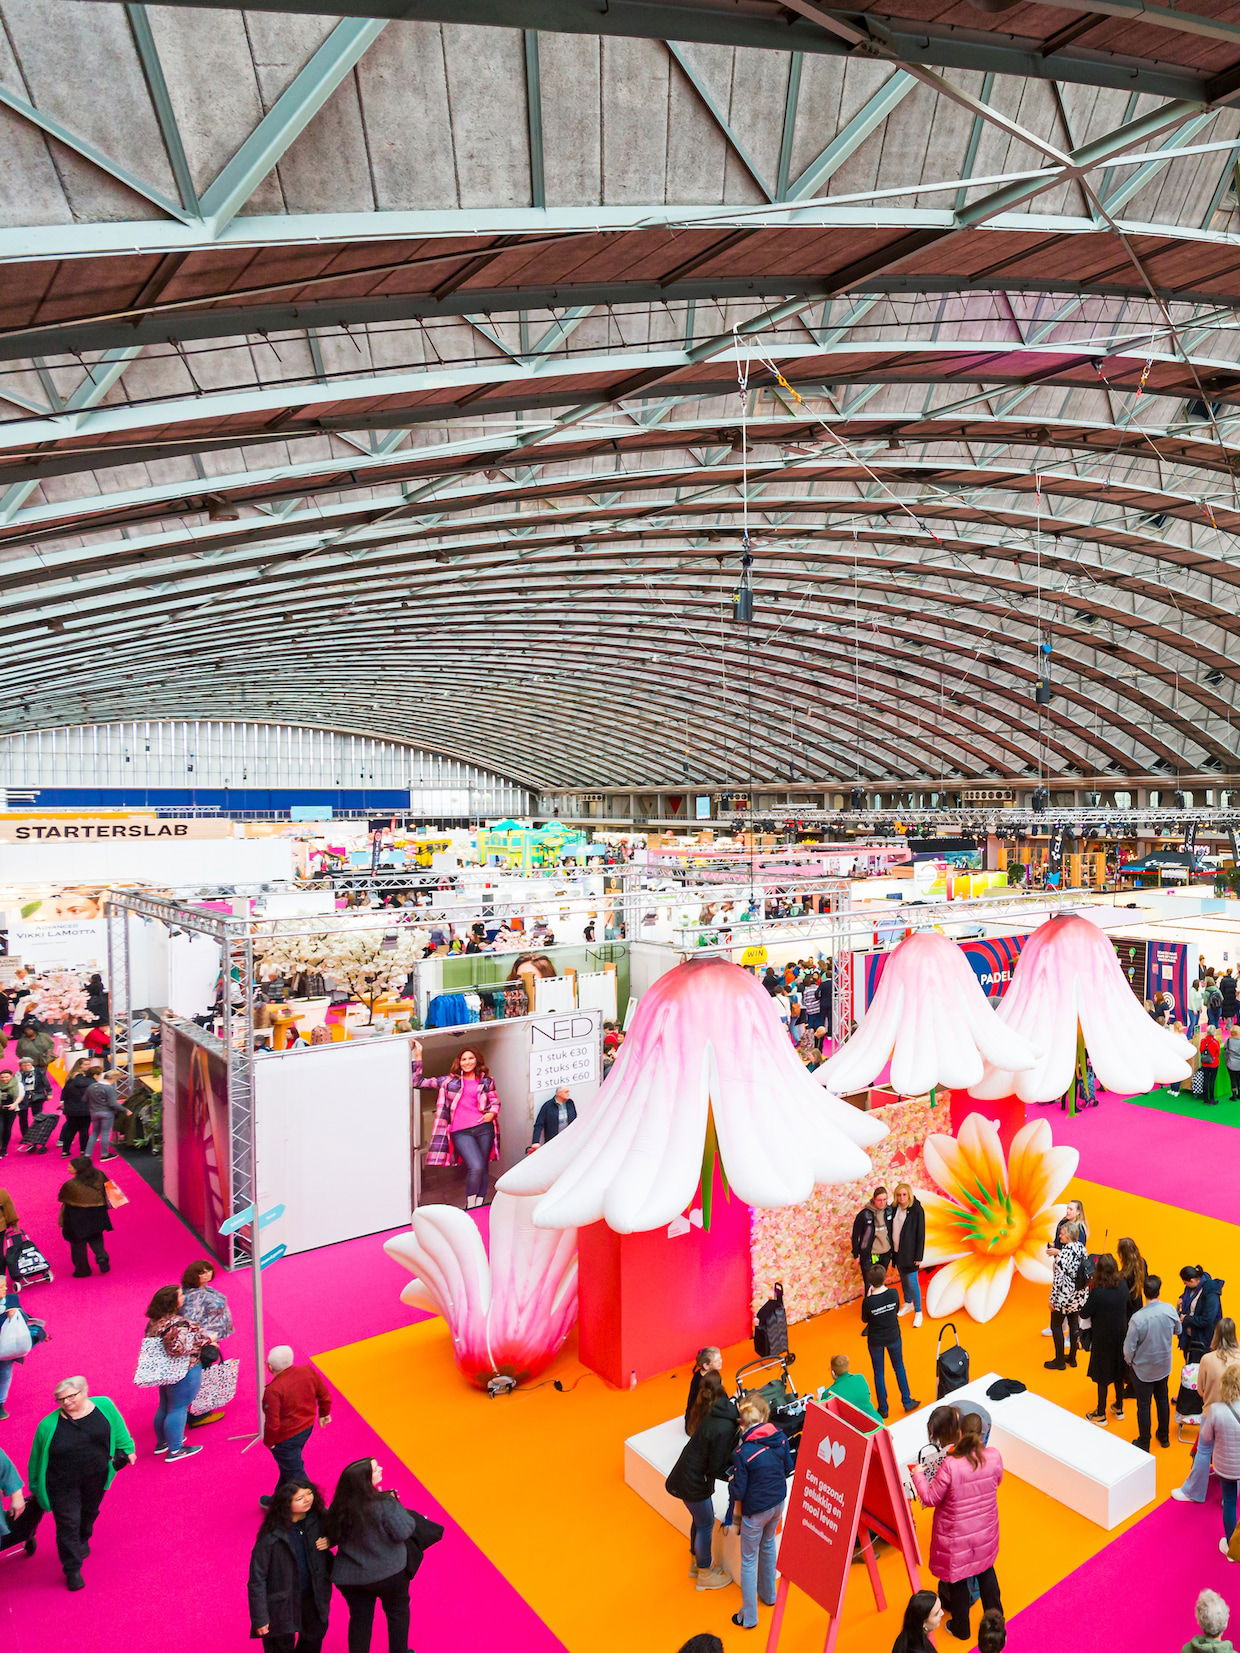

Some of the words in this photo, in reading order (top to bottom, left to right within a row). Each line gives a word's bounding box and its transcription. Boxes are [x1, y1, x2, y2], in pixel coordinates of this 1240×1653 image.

[15, 824, 188, 839] STARTERSLAB
[747, 949, 764, 958] WIN
[981, 970, 1013, 986] PADEL
[531, 1017, 593, 1045] NED
[539, 1055, 543, 1063] 1
[546, 1050, 568, 1062] stuk
[570, 1047, 588, 1057] €30
[536, 1067, 542, 1076] 2
[544, 1063, 570, 1075] stuks
[572, 1059, 590, 1069] €50
[536, 1079, 542, 1089] 3
[544, 1075, 570, 1087] stuks
[572, 1071, 590, 1082] €60
[806, 1469, 819, 1486] Een
[818, 1480, 845, 1507] gezond,
[803, 1486, 833, 1514] gelukkig
[832, 1507, 842, 1519] en
[802, 1500, 820, 1518] mooi
[820, 1509, 839, 1533] leven
